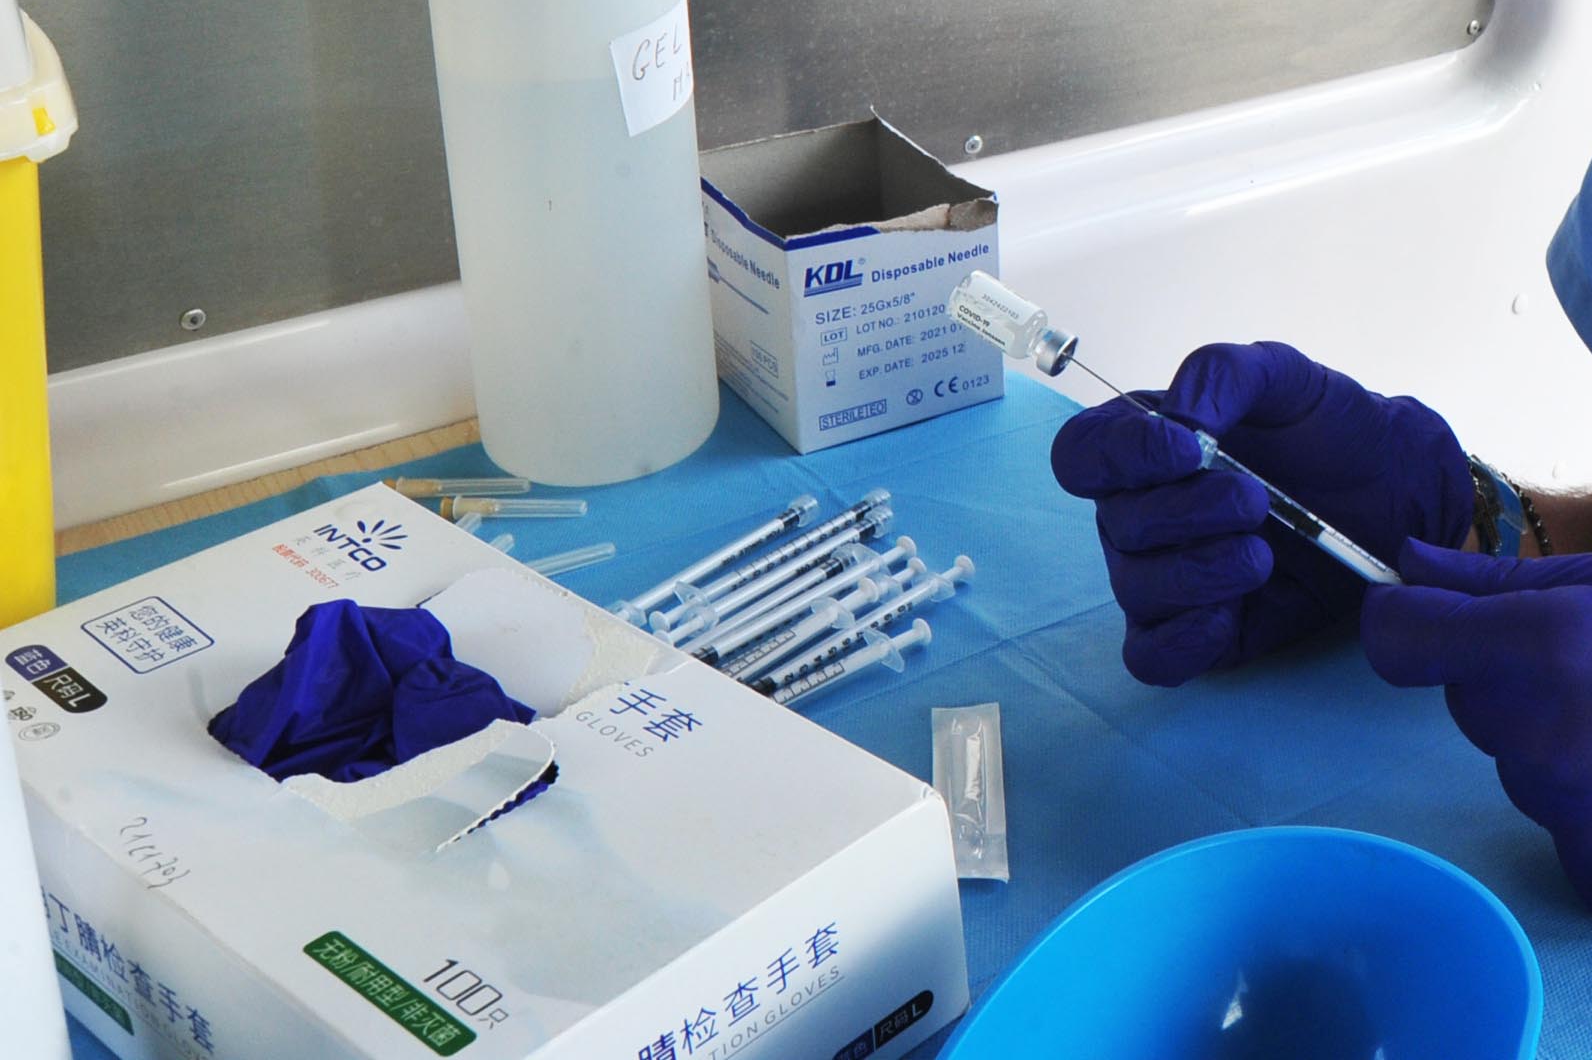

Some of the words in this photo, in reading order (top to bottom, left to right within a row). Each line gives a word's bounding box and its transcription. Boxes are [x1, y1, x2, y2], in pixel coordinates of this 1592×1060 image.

[632, 22, 682, 81] GEL
[749, 259, 781, 290] Needle
[804, 259, 863, 291] KDL
[871, 257, 944, 284] Disposable
[948, 243, 990, 264] Needle
[815, 305, 857, 325] SIZE:
[856, 321, 876, 335] LOT
[823, 331, 844, 343] LOT
[920, 325, 947, 342] 2021
[921, 348, 949, 364] 2025
[962, 374, 990, 391] 0123
[313, 523, 387, 572] INTCO
[609, 681, 703, 743] 手套
[575, 710, 654, 758] GLOVES
[764, 964, 842, 1026] GLOVES
